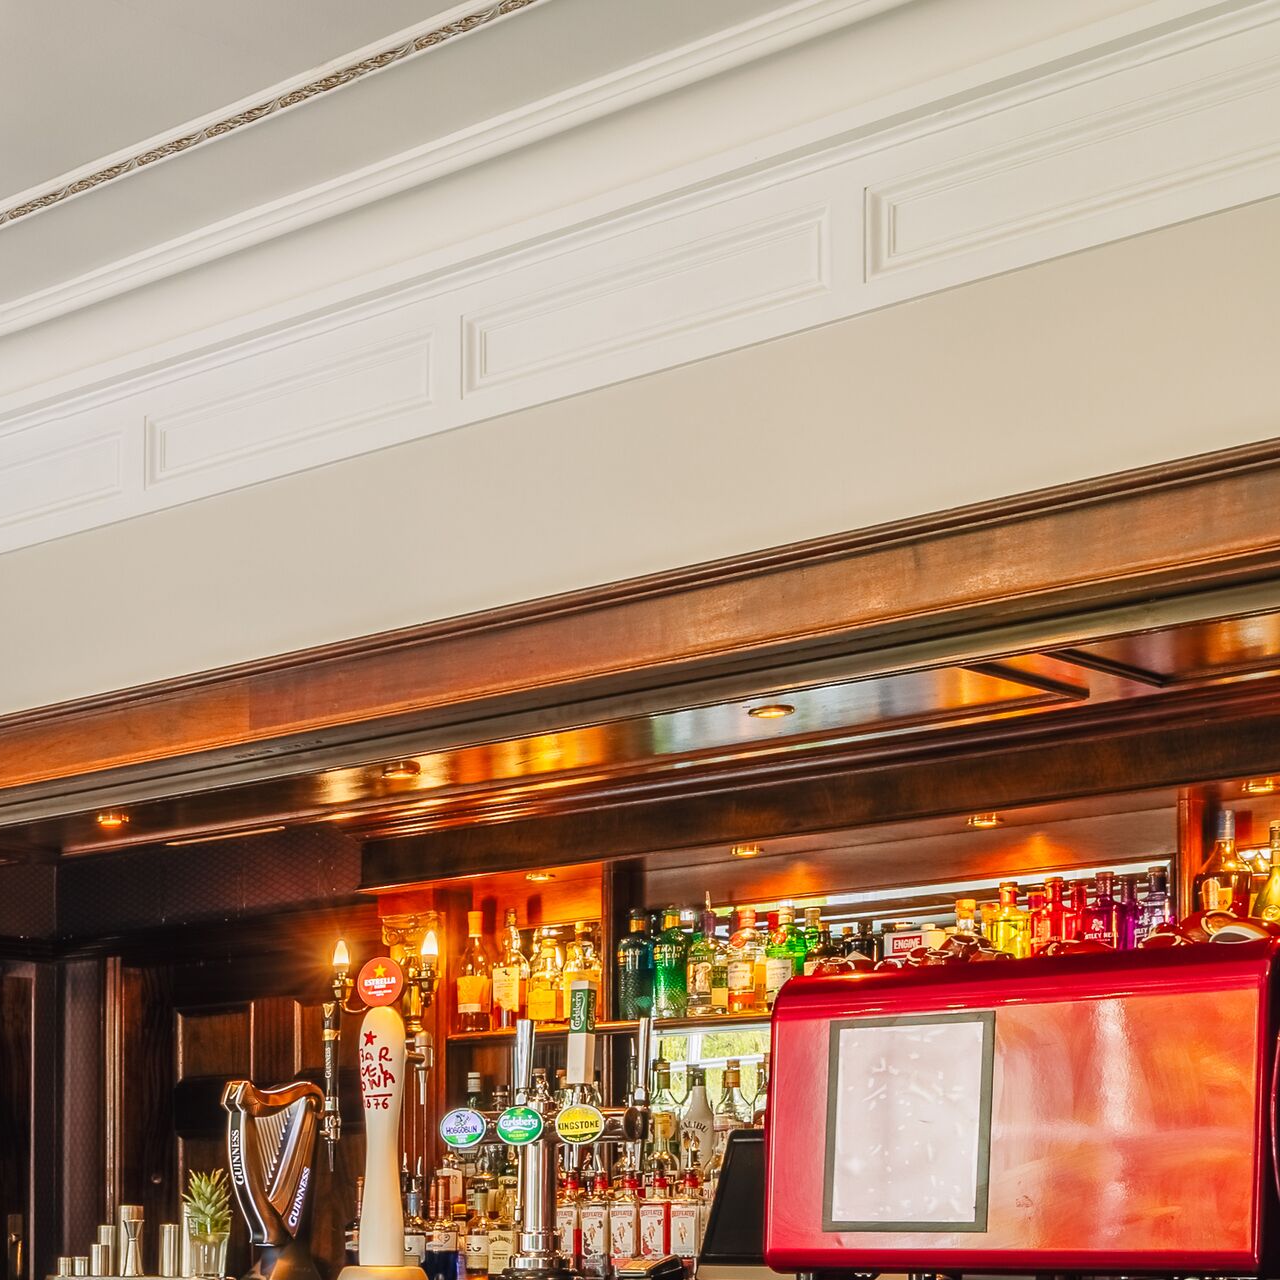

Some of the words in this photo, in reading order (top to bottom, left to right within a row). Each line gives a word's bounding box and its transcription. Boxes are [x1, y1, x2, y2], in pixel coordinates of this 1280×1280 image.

[893, 938, 921, 950] ENGINE
[364, 977, 396, 987] ESTRELLA
[570, 992, 586, 1030] Carlsberg
[324, 1047, 332, 1079] GUINNESS
[365, 1097, 389, 1110] 876
[446, 1125, 478, 1135] HOBGOBLIN
[500, 1115, 538, 1131] Carlsberg
[558, 1120, 599, 1130] KINGSTONE
[231, 1129, 245, 1185] GUINNESS
[288, 1166, 311, 1227] GUINNESS
